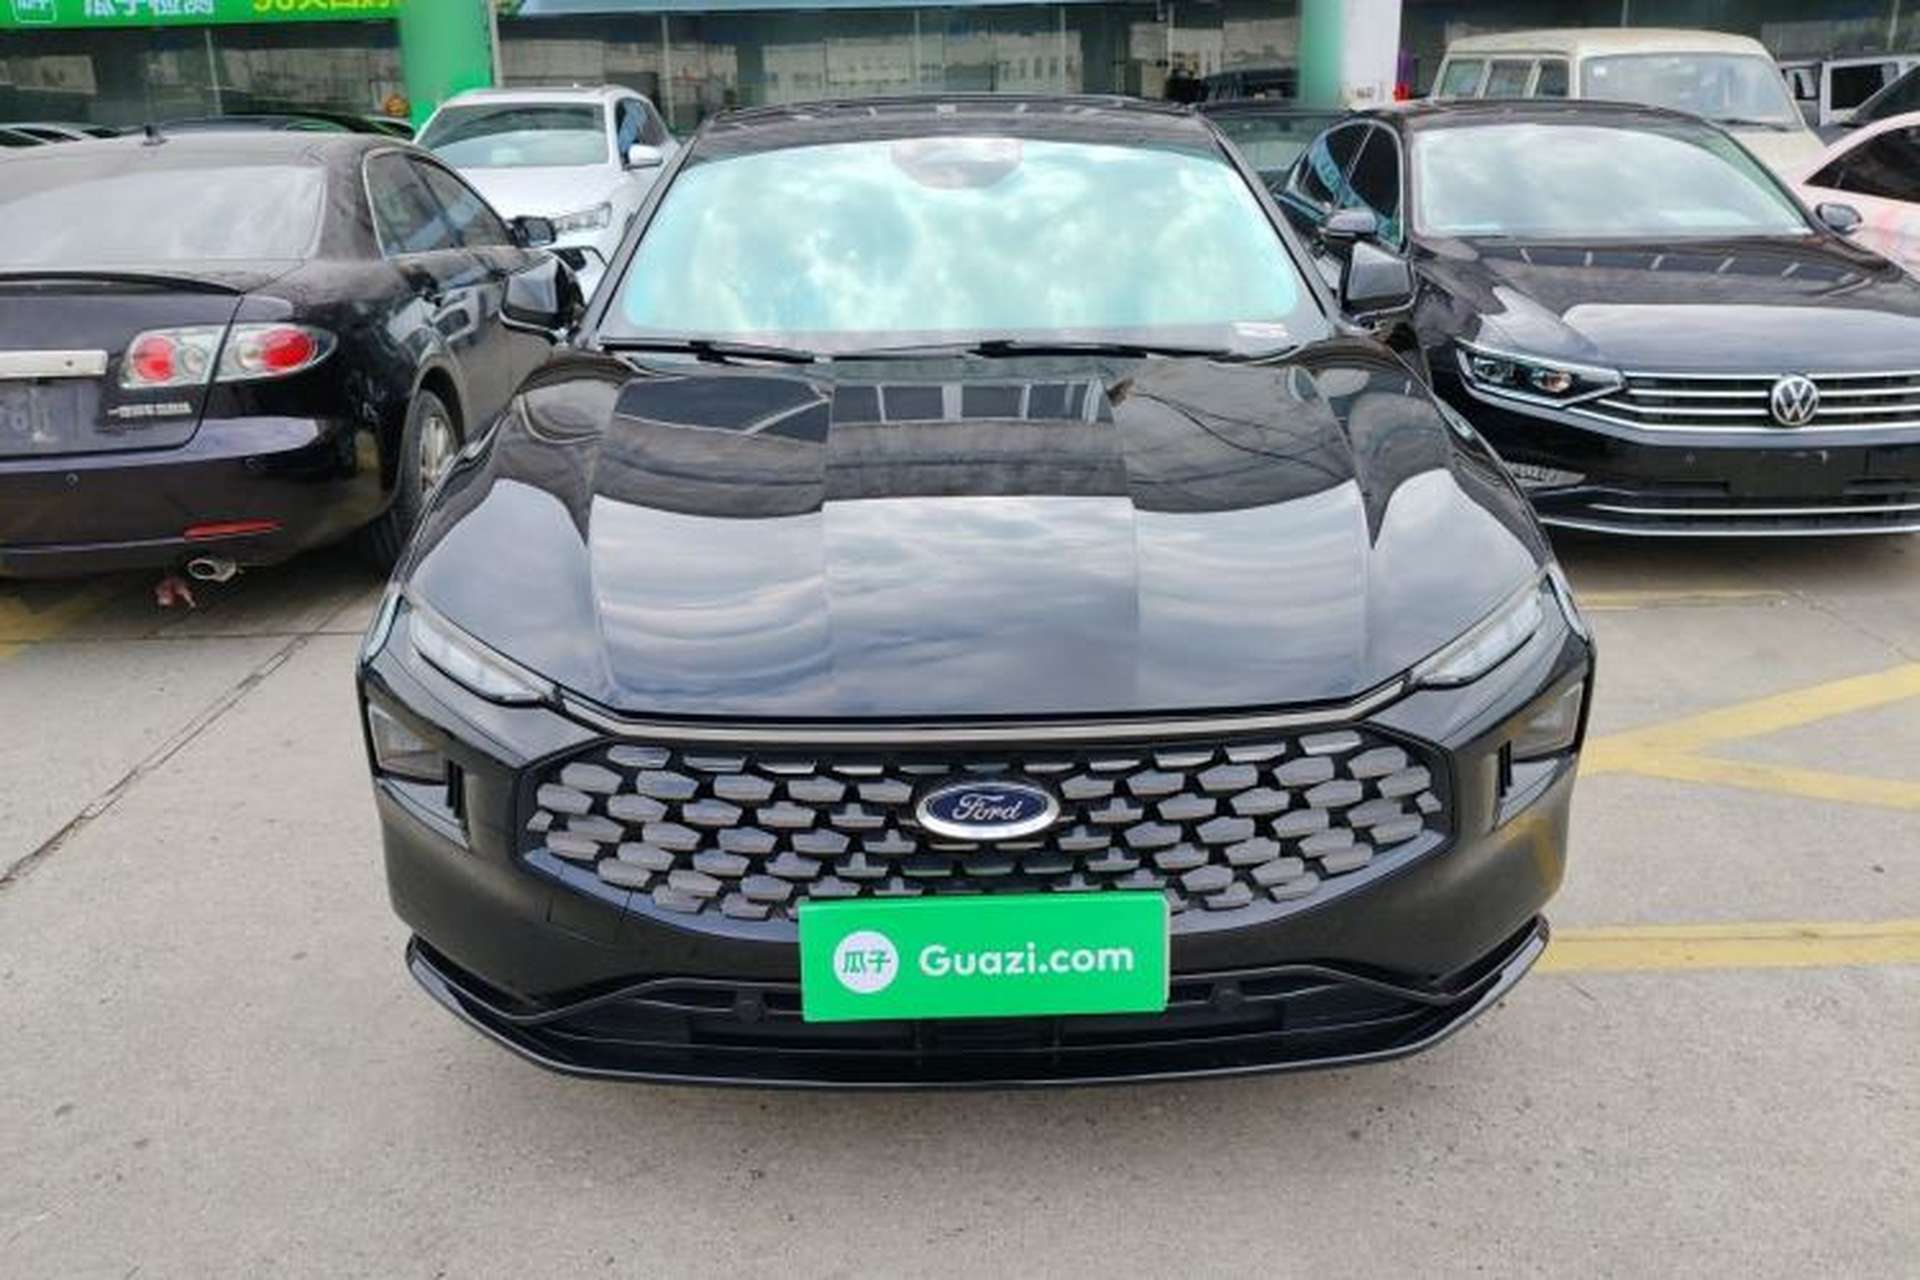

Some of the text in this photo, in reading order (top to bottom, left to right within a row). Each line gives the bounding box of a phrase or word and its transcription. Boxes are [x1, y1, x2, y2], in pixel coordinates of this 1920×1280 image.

[952, 793, 1023, 820] Ford
[843, 951, 891, 974] 瓜子
[919, 942, 1134, 976] Guazi.com
